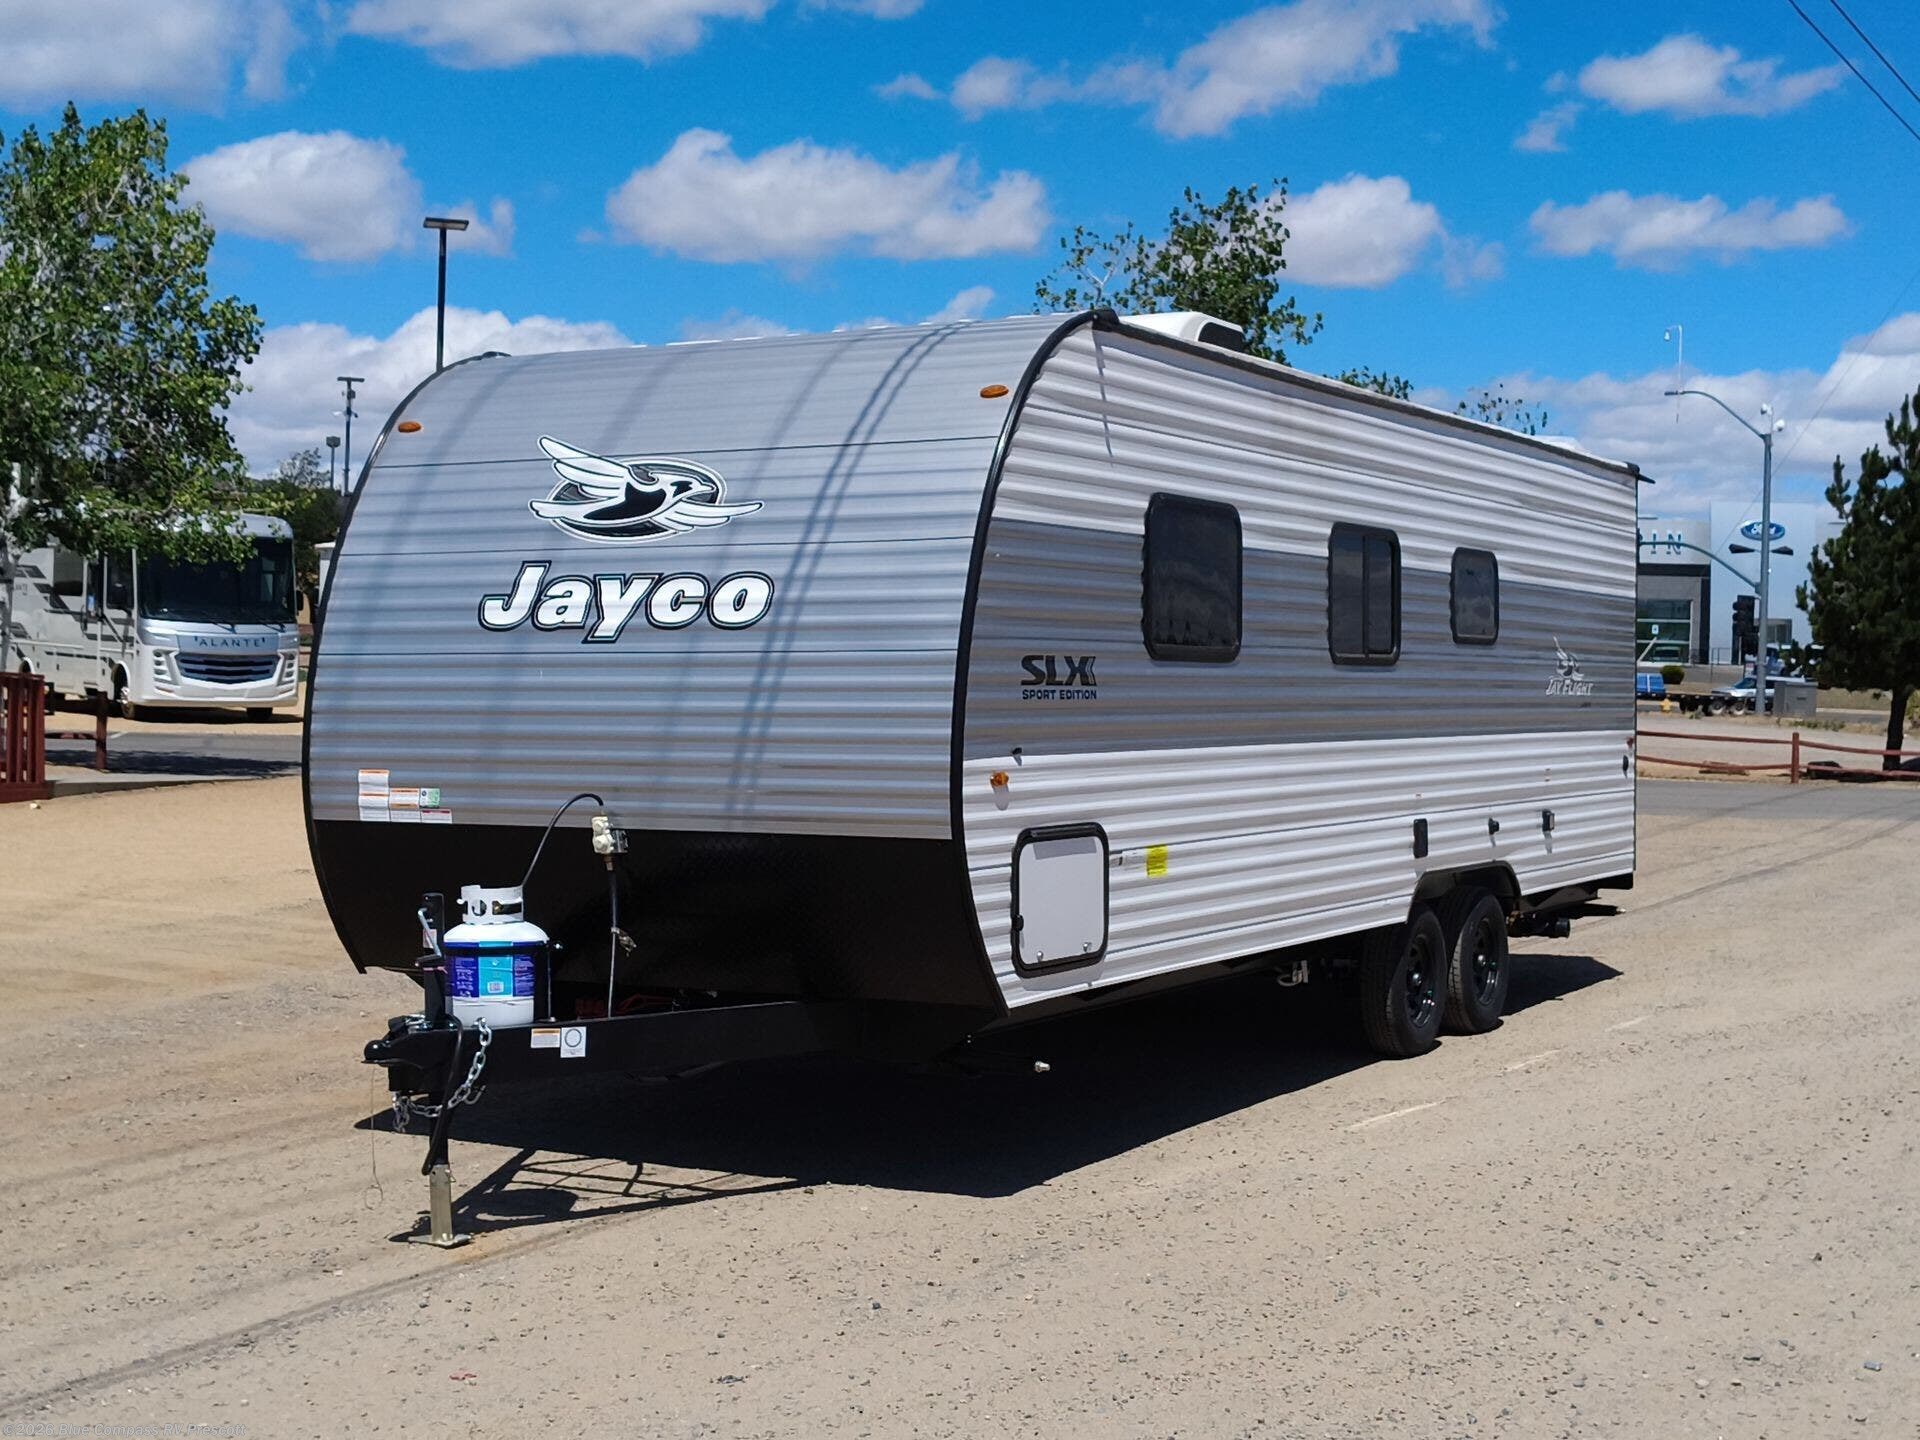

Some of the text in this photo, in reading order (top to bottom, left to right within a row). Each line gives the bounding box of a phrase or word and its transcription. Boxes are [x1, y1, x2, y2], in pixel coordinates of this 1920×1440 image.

[1638, 532, 1682, 555] IN
[479, 560, 775, 644] Jayco
[199, 638, 261, 648] ALANTE
[1021, 655, 1097, 687] SLX
[1022, 689, 1097, 700] SPORT EDITION
